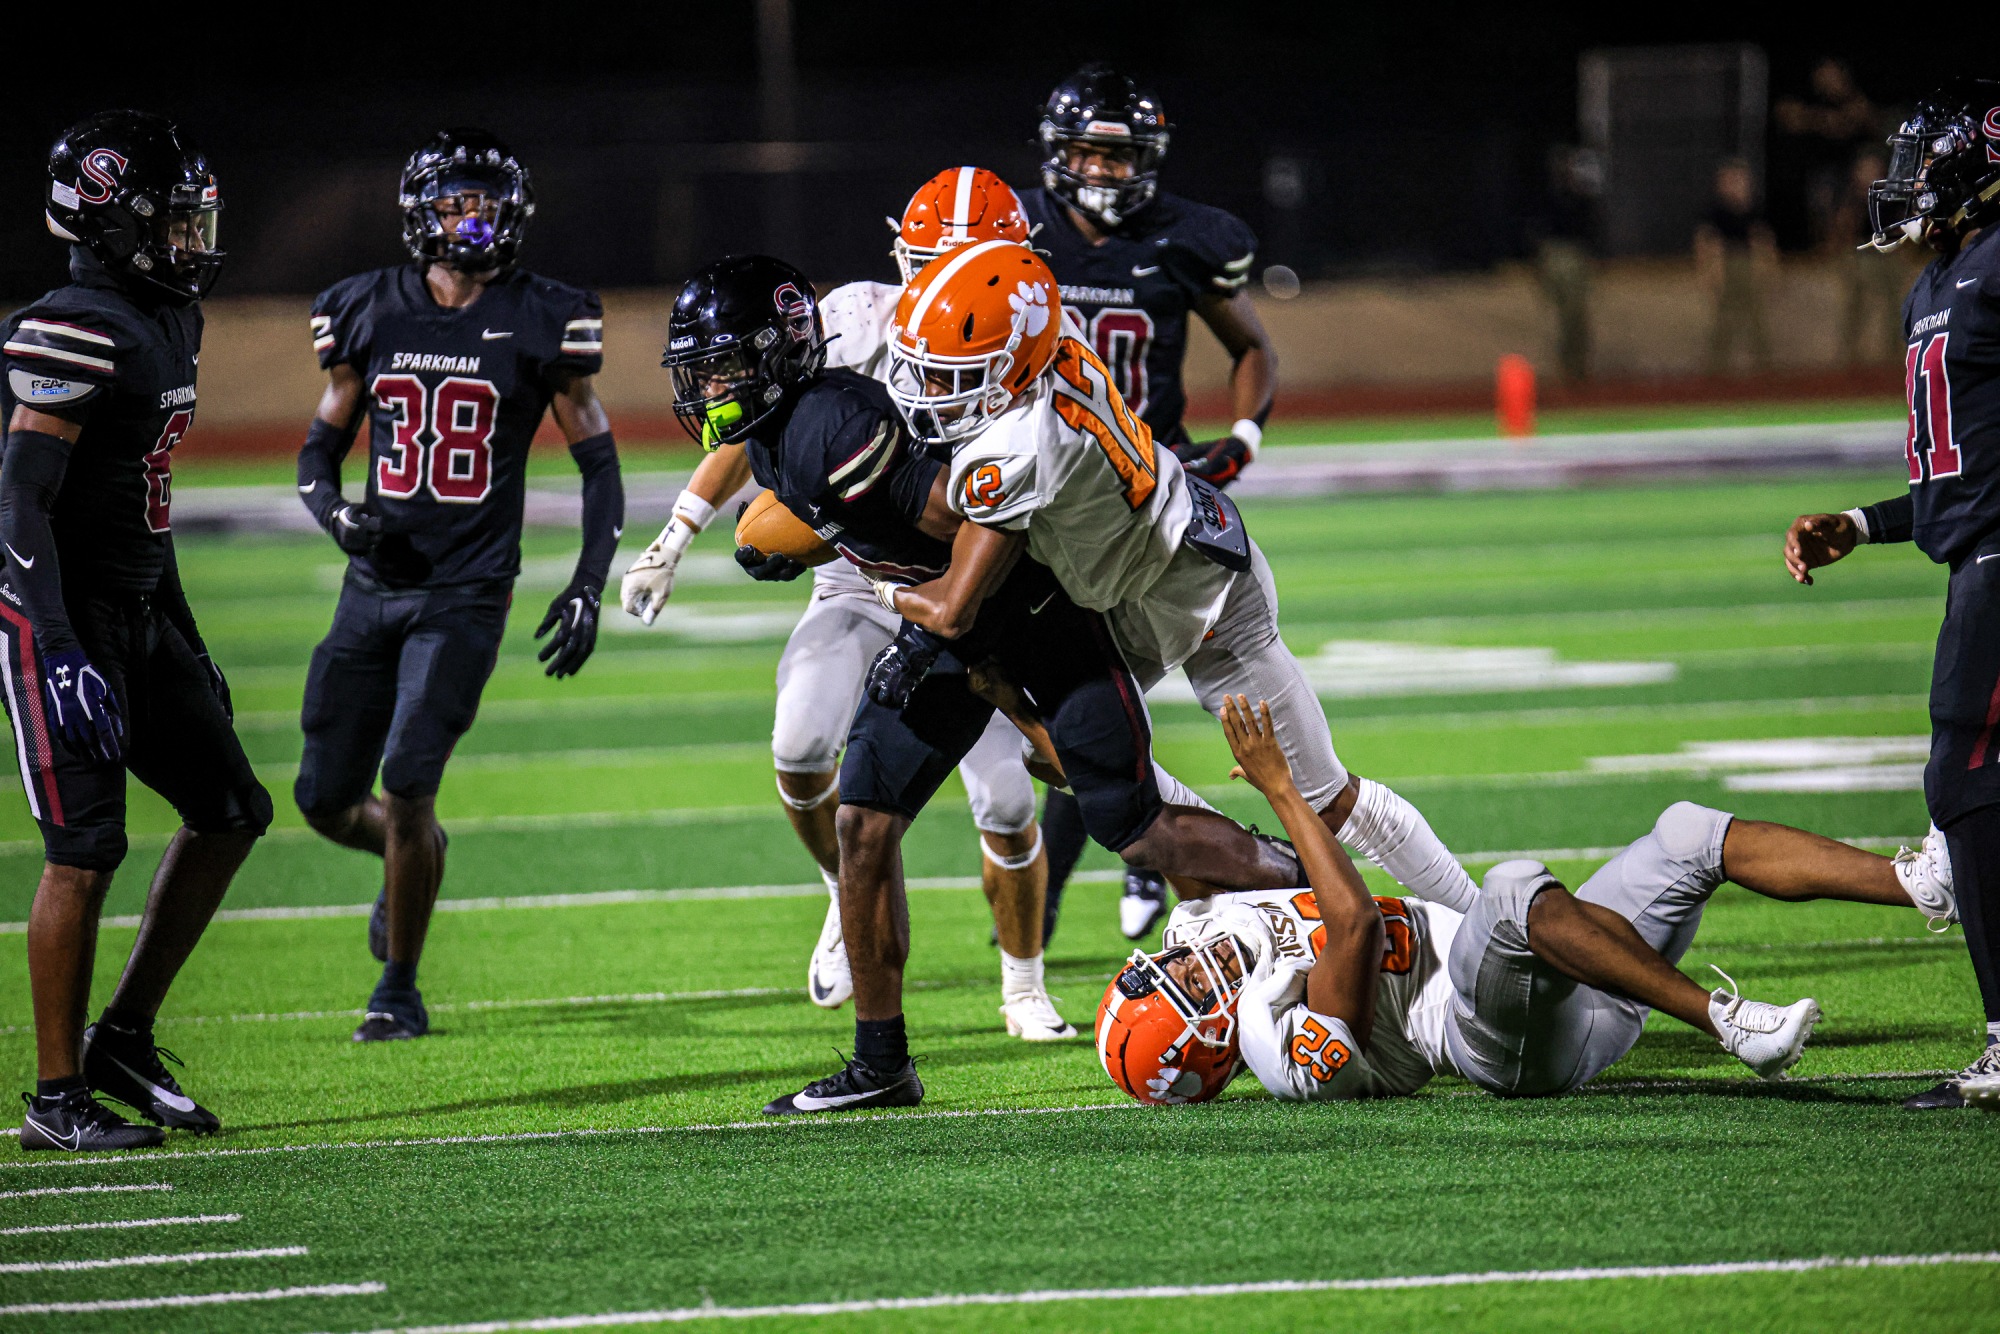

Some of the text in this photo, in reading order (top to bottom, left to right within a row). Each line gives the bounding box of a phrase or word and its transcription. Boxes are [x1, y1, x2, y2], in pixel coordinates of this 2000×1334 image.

[391, 352, 480, 373] SPARKMAN
[670, 337, 695, 350] Riddell
[371, 374, 500, 504] 38
[1051, 335, 1157, 514] 12
[964, 464, 1006, 508] 12
[1288, 1015, 1352, 1084] 29
